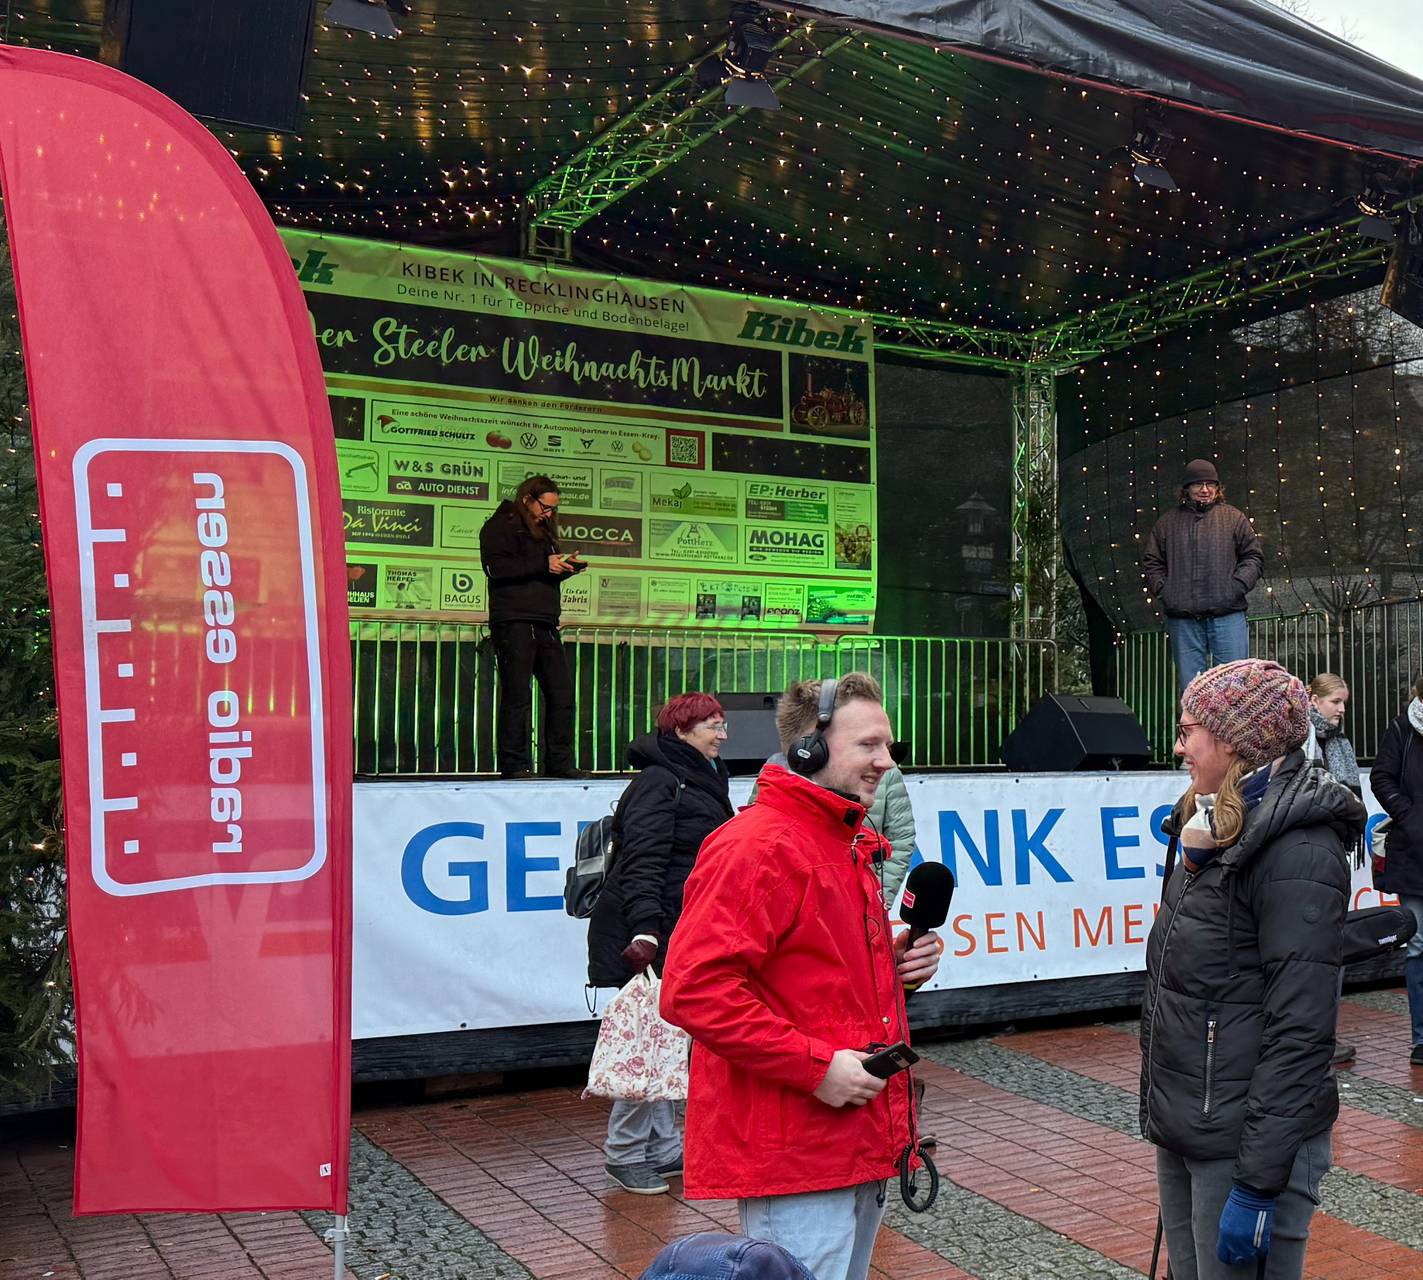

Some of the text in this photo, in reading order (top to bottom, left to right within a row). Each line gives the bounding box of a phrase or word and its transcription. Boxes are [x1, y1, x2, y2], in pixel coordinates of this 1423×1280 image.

[402, 261, 685, 314] KIBEK IN RECKLINGHAUSEN
[397, 283, 439, 299] Deine
[444, 290, 465, 303] Nr.
[471, 293, 477, 305] 1
[483, 294, 502, 308] für
[508, 297, 569, 317] Teppiche
[574, 308, 598, 320] und
[372, 317, 490, 365] Steeler
[737, 310, 868, 354] Kibek
[391, 408, 408, 417] Eine
[410, 409, 438, 420] schöne
[439, 413, 499, 426] Weihnachtszeit
[500, 418, 531, 430] wünscht
[544, 423, 609, 437] Automobilpartner
[391, 426, 476, 441] GOTTFRIED SCHULTZ
[440, 461, 484, 477] GRÜN
[418, 482, 445, 493] AUTO
[447, 484, 480, 495] DIENST
[357, 505, 407, 517] Ristorante
[371, 511, 423, 532] Vinci
[558, 525, 634, 541] MOCCA
[749, 529, 824, 548] MOHAG
[444, 593, 481, 604] BAGUS
